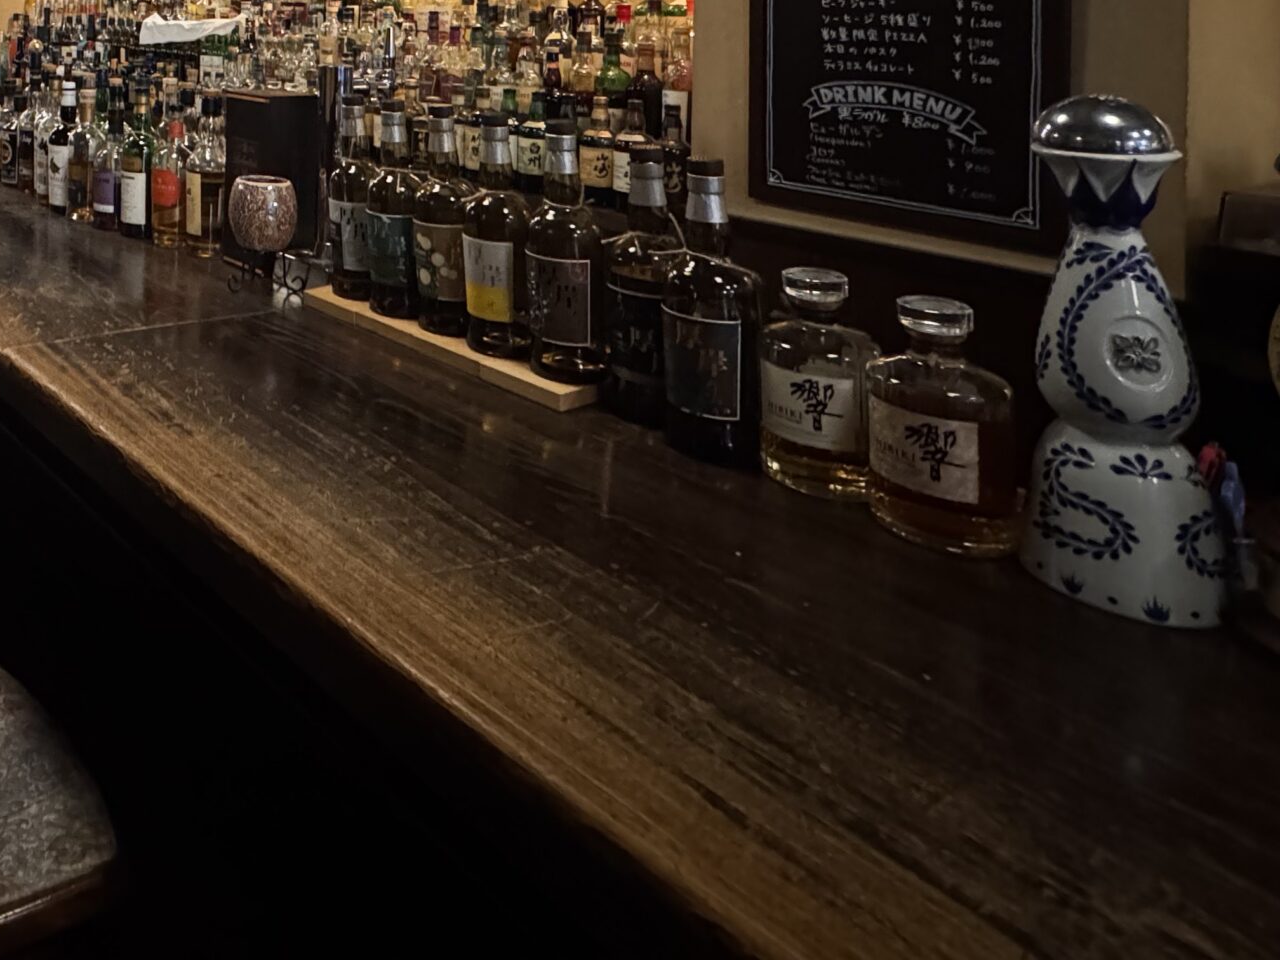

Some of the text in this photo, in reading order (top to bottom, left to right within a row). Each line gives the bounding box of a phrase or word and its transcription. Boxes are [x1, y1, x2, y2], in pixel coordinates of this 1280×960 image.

[820, 85, 963, 121] DRINK MENU
[790, 379, 844, 432] 響
[904, 423, 967, 482] 響
